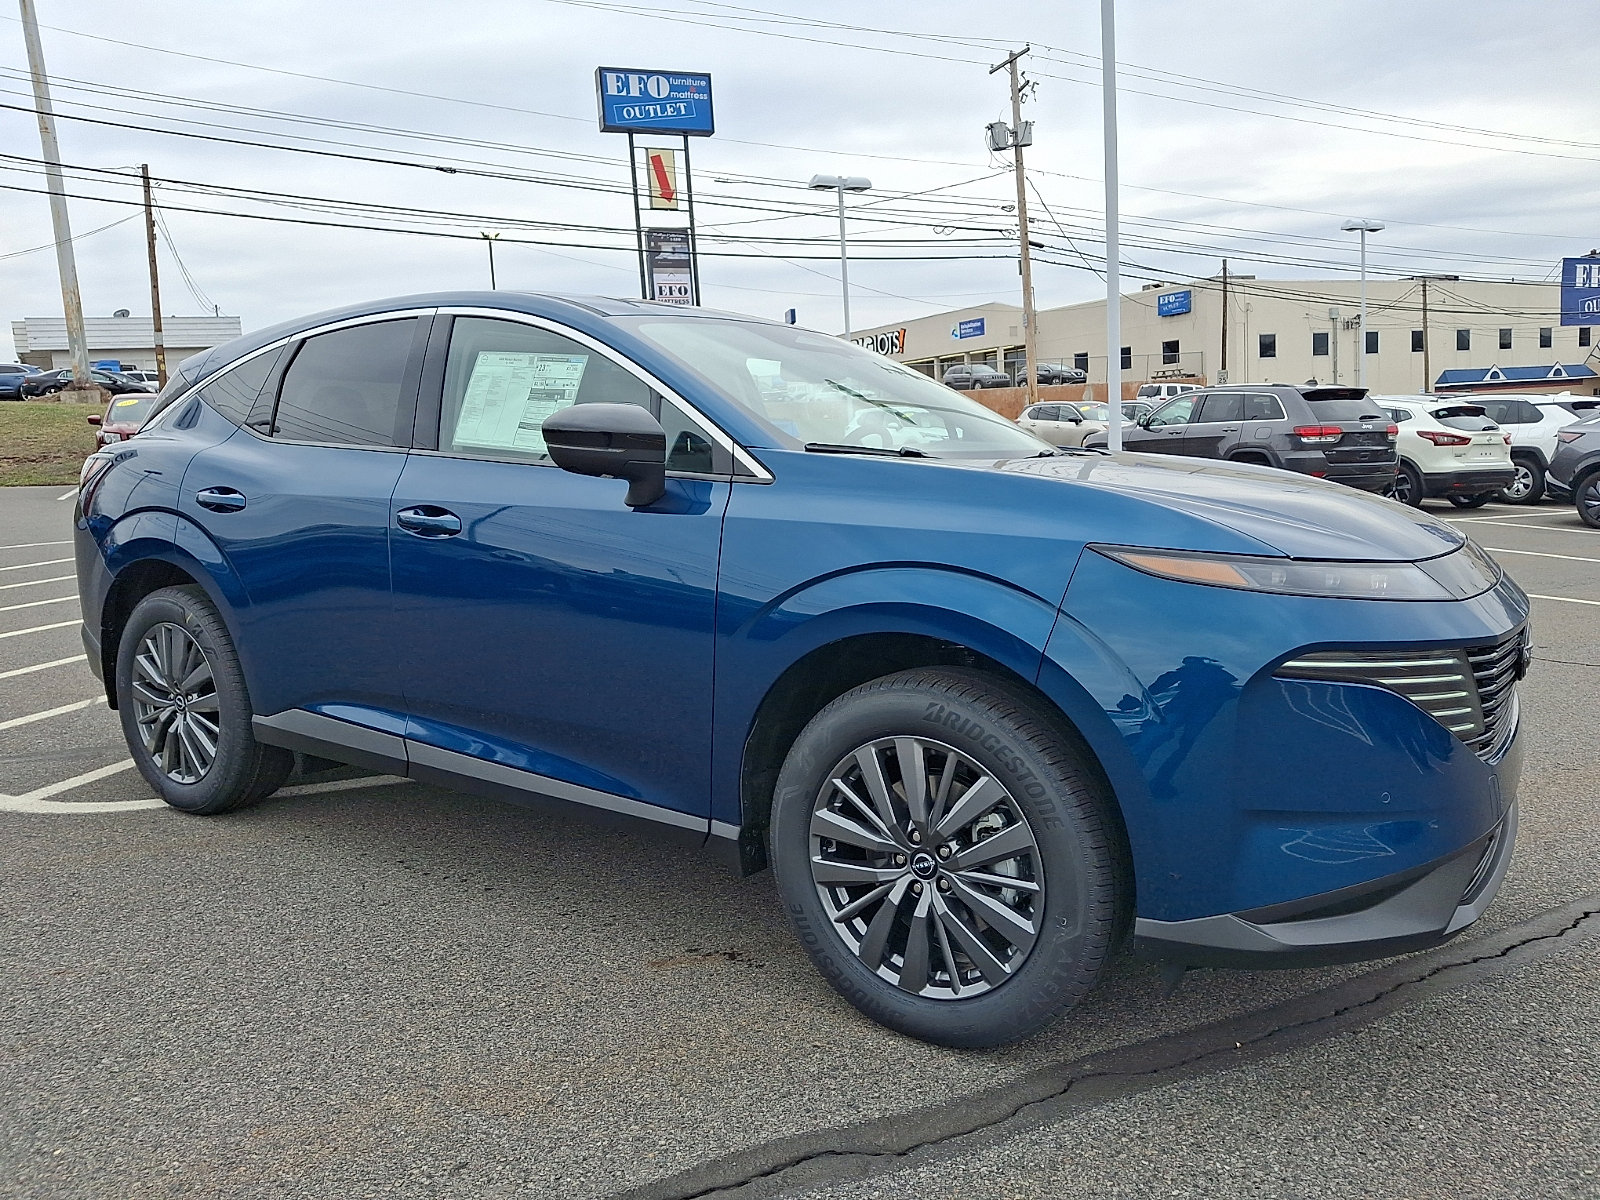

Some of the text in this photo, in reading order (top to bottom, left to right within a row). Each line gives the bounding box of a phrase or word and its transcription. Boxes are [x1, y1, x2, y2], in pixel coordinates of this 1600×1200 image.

[604, 72, 706, 98] EFO furniture
[670, 91, 708, 100] mattress
[623, 102, 687, 119] OUTLET
[658, 285, 689, 296] EFO
[1160, 295, 1175, 304] EFO
[922, 702, 1065, 830] BRIDGESTONE
